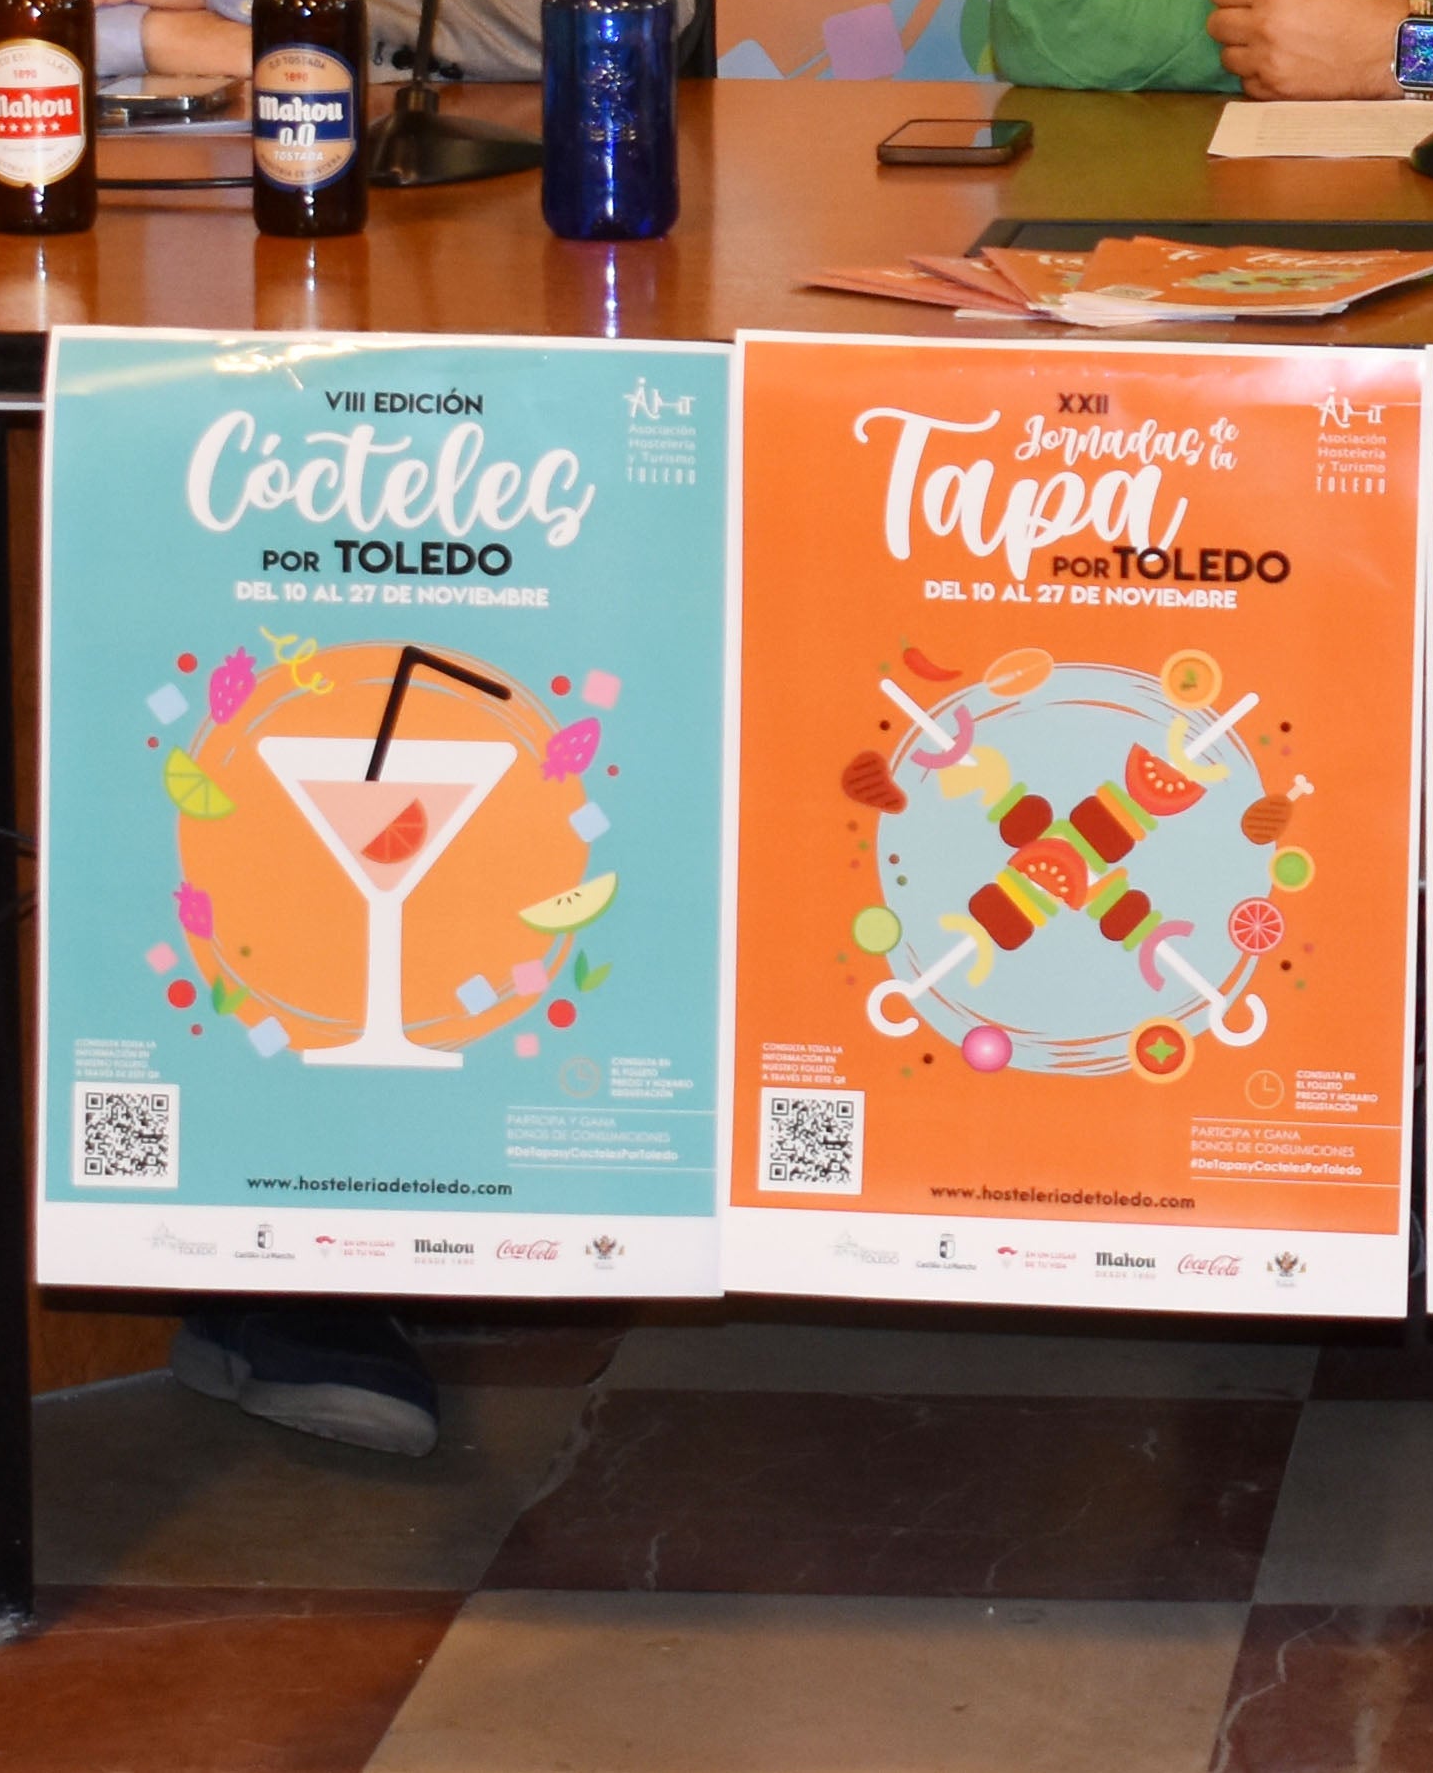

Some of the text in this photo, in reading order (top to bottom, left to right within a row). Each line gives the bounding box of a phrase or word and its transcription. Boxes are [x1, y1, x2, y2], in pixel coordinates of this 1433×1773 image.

[258, 95, 345, 123] Mahou
[325, 388, 483, 415] VIII EDICIÓN
[1058, 393, 1108, 414] XXII
[1015, 414, 1240, 466] Jornadas de
[1209, 444, 1238, 471] la
[186, 409, 596, 547] Cócteles
[854, 406, 1188, 581] Tapa
[263, 540, 512, 576] POR TOLEDO
[1052, 545, 1292, 584] POR TOLEDO
[235, 581, 549, 607] DEL 10 AL 27 DE NOVIEMBRE
[924, 580, 1237, 609] DEL 10 AL 27 DE NOVIEMBRE
[247, 1176, 512, 1195] www.hosteleriadetoledo.com
[930, 1184, 1195, 1208] www.hosteleriadetoledo.com
